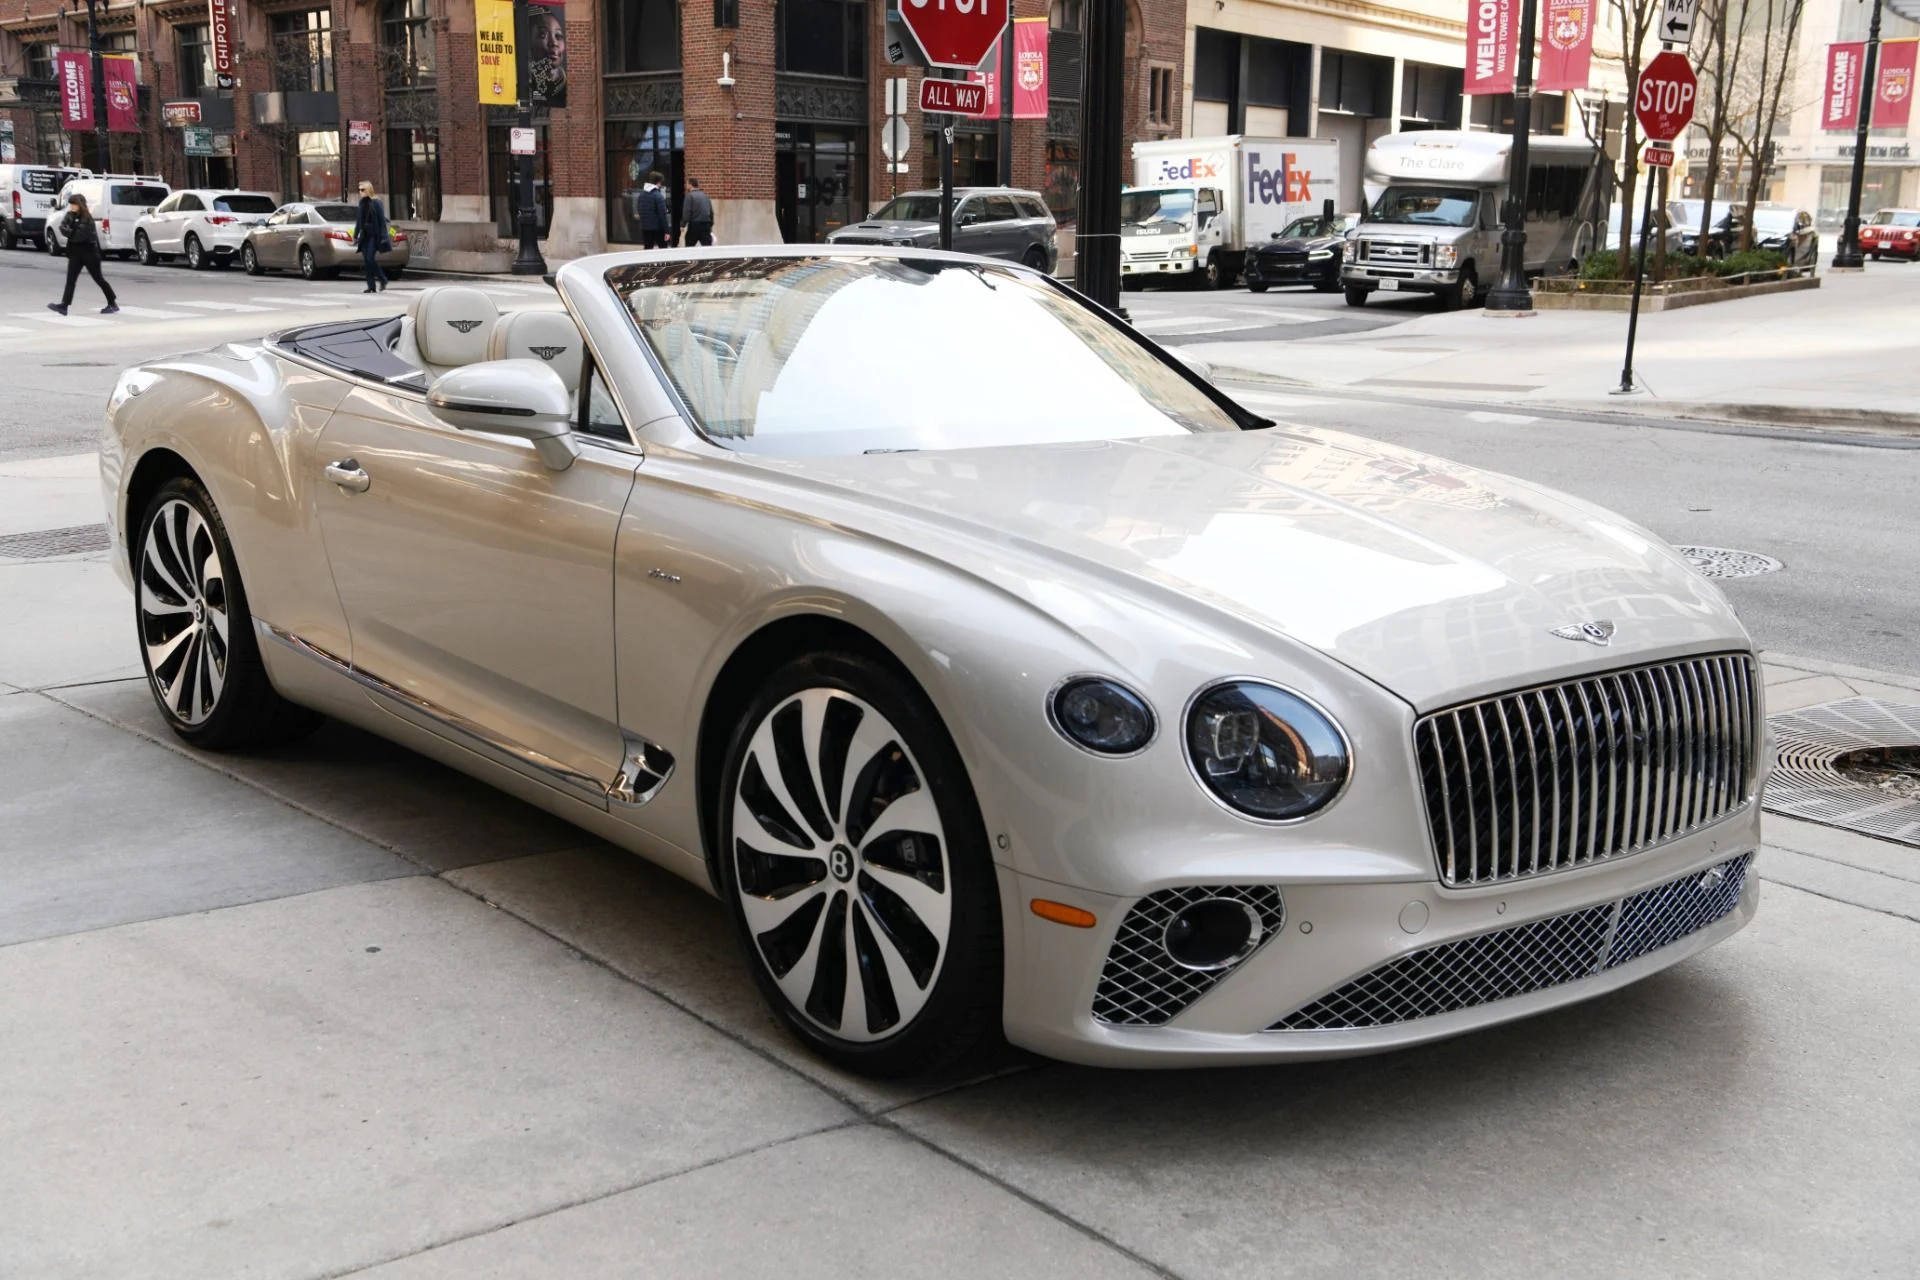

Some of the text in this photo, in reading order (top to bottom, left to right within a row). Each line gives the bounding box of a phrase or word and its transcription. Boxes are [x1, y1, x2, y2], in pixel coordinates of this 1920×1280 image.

[1668, 0, 1692, 12] WAY
[215, 0, 229, 69] CHIPOTLE
[480, 31, 503, 41] WE ARE
[1500, 12, 1508, 41] TOWER
[480, 43, 513, 54] CALLED TO
[1476, 0, 1497, 80] WELCO
[480, 55, 500, 65] SOLVE
[1497, 44, 1506, 72] WATER
[64, 60, 81, 121] WELCOME
[927, 86, 981, 108] ALL WAY
[1640, 78, 1694, 114] STOP
[1829, 51, 1849, 121] WELCOME
[166, 107, 197, 118] CHIPOTLE
[1400, 156, 1464, 170] The Clare
[1646, 151, 1673, 165] ALL WAY
[1248, 152, 1312, 205] FedEx
